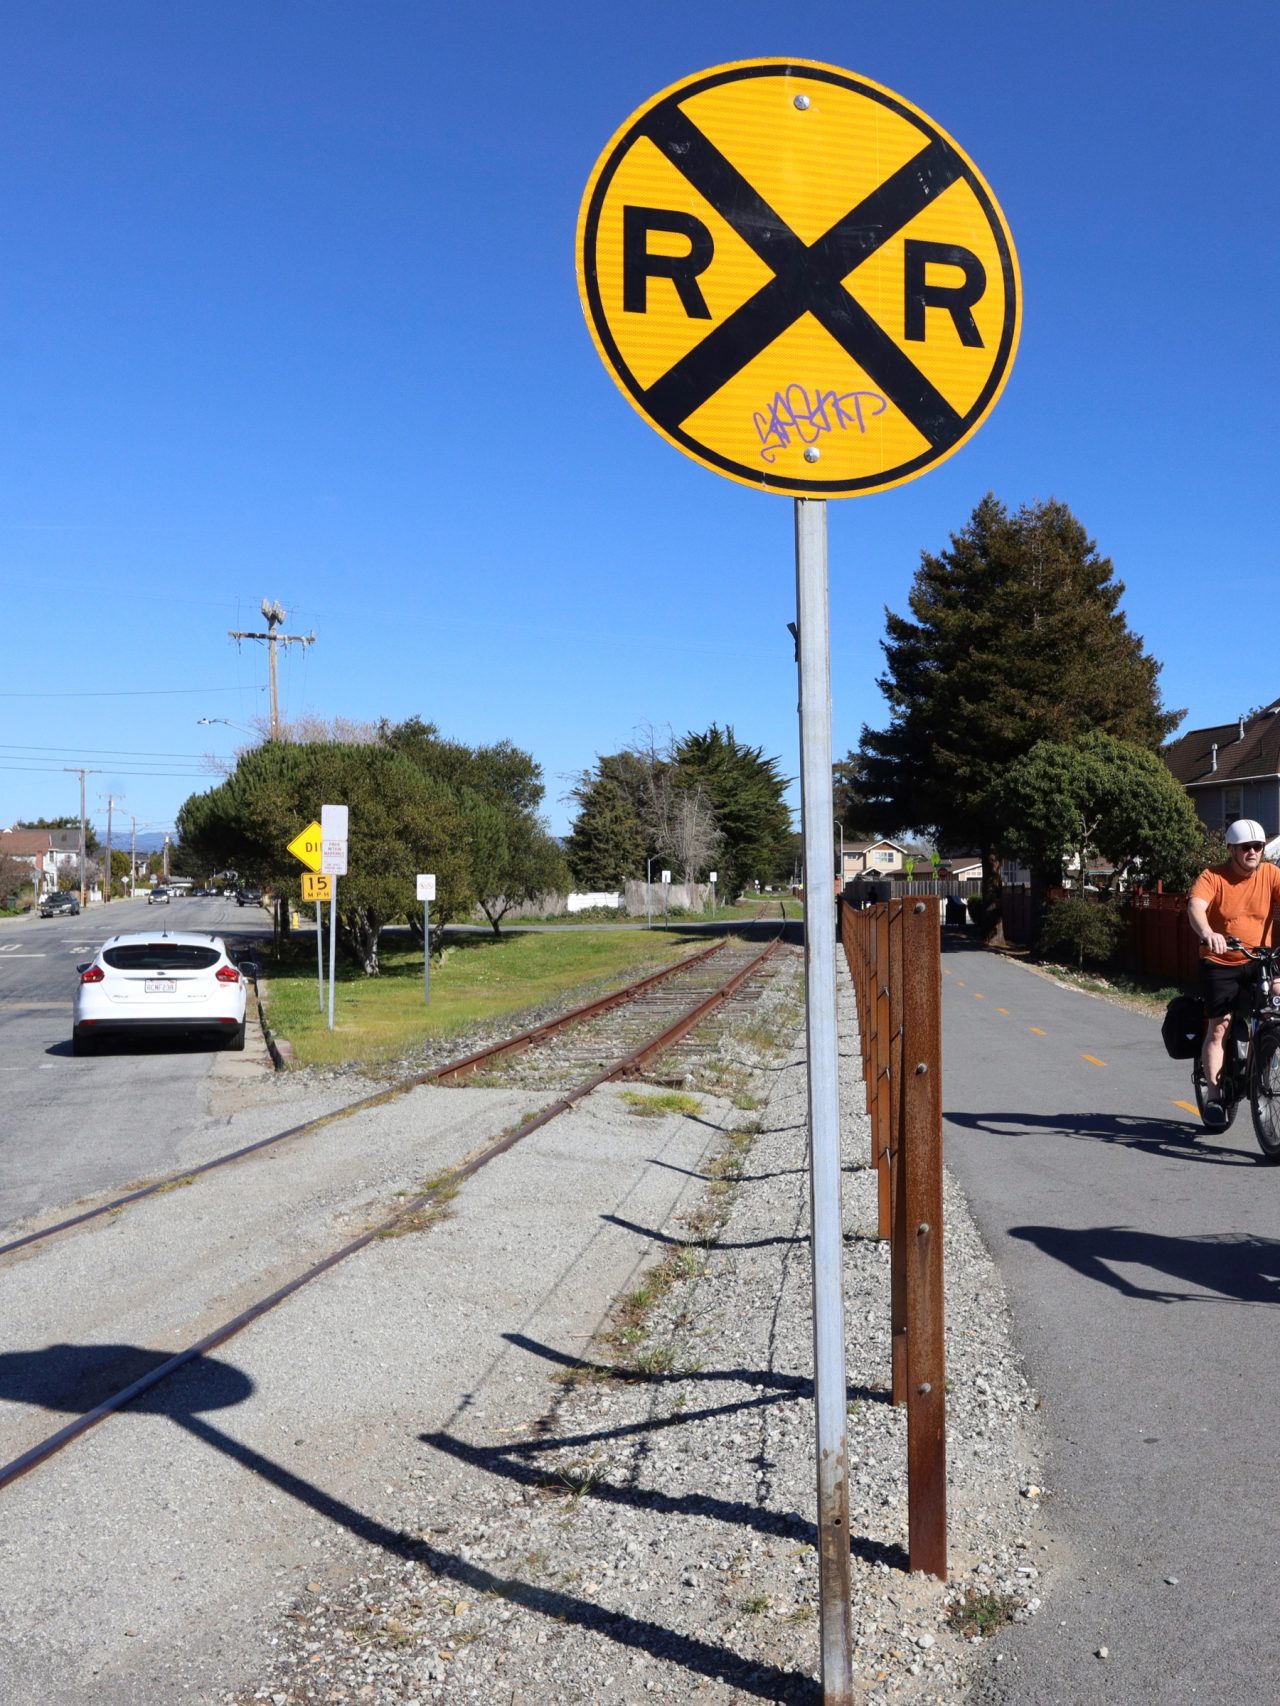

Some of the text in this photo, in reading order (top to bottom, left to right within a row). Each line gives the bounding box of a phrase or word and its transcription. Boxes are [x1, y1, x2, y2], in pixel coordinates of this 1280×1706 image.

[623, 205, 988, 349] R R
[309, 876, 327, 890] 15
